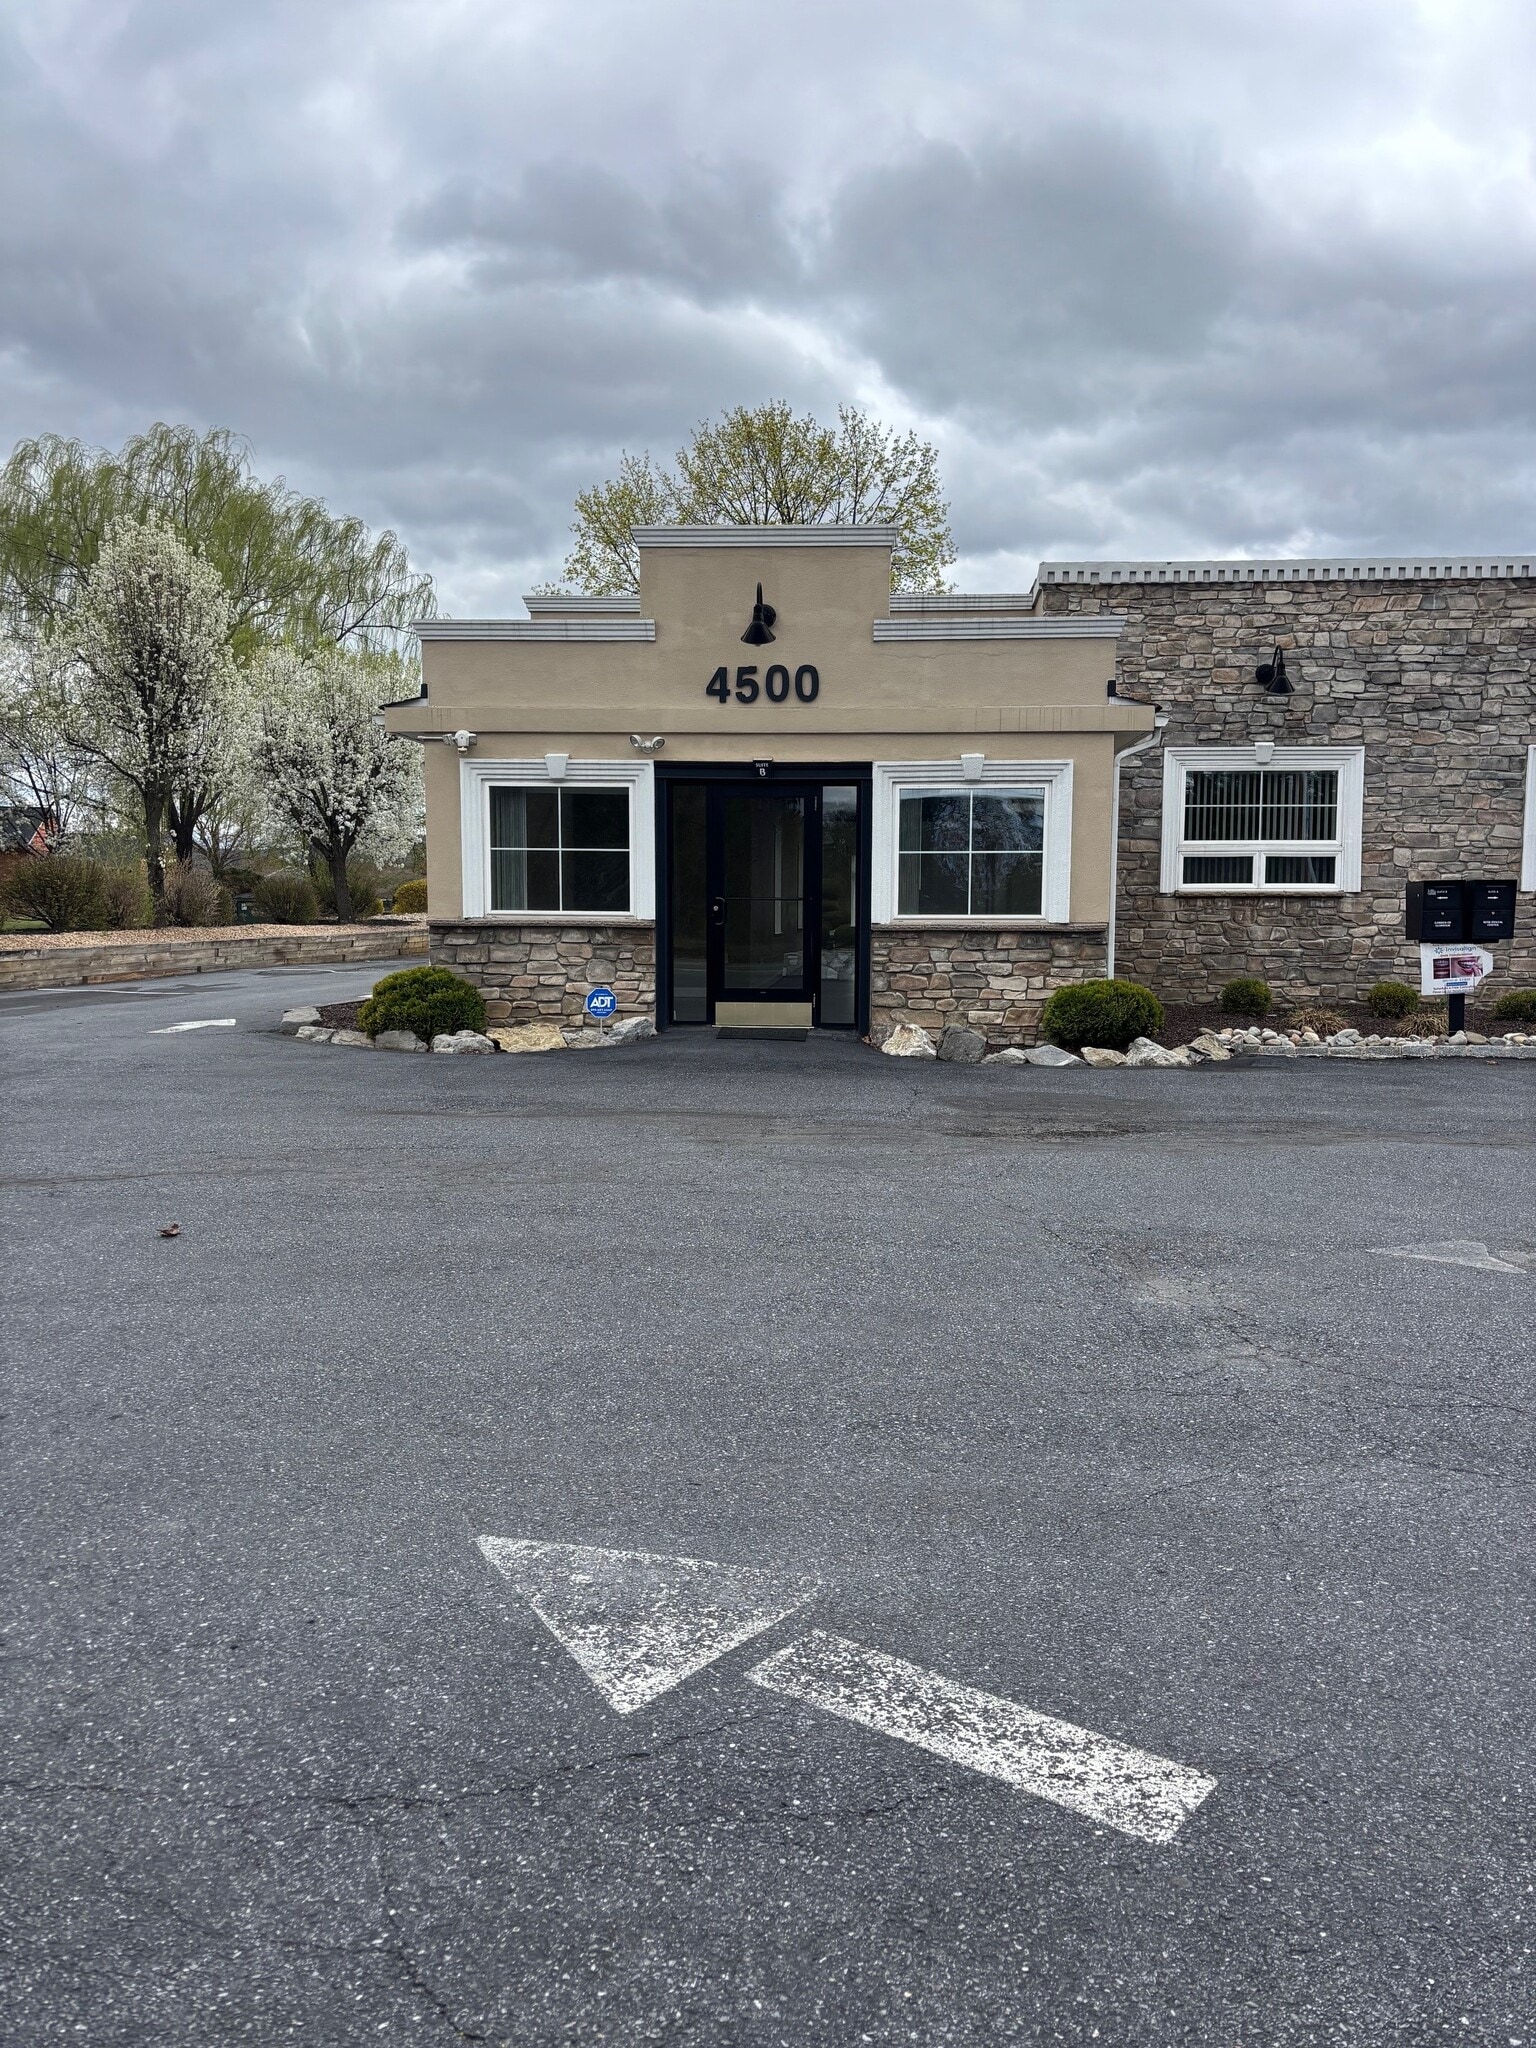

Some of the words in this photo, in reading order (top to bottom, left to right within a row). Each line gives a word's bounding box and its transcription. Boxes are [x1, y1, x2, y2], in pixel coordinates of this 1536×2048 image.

[705, 664, 820, 703] 4500
[759, 768, 766, 776] B
[590, 996, 614, 1008] ADT
